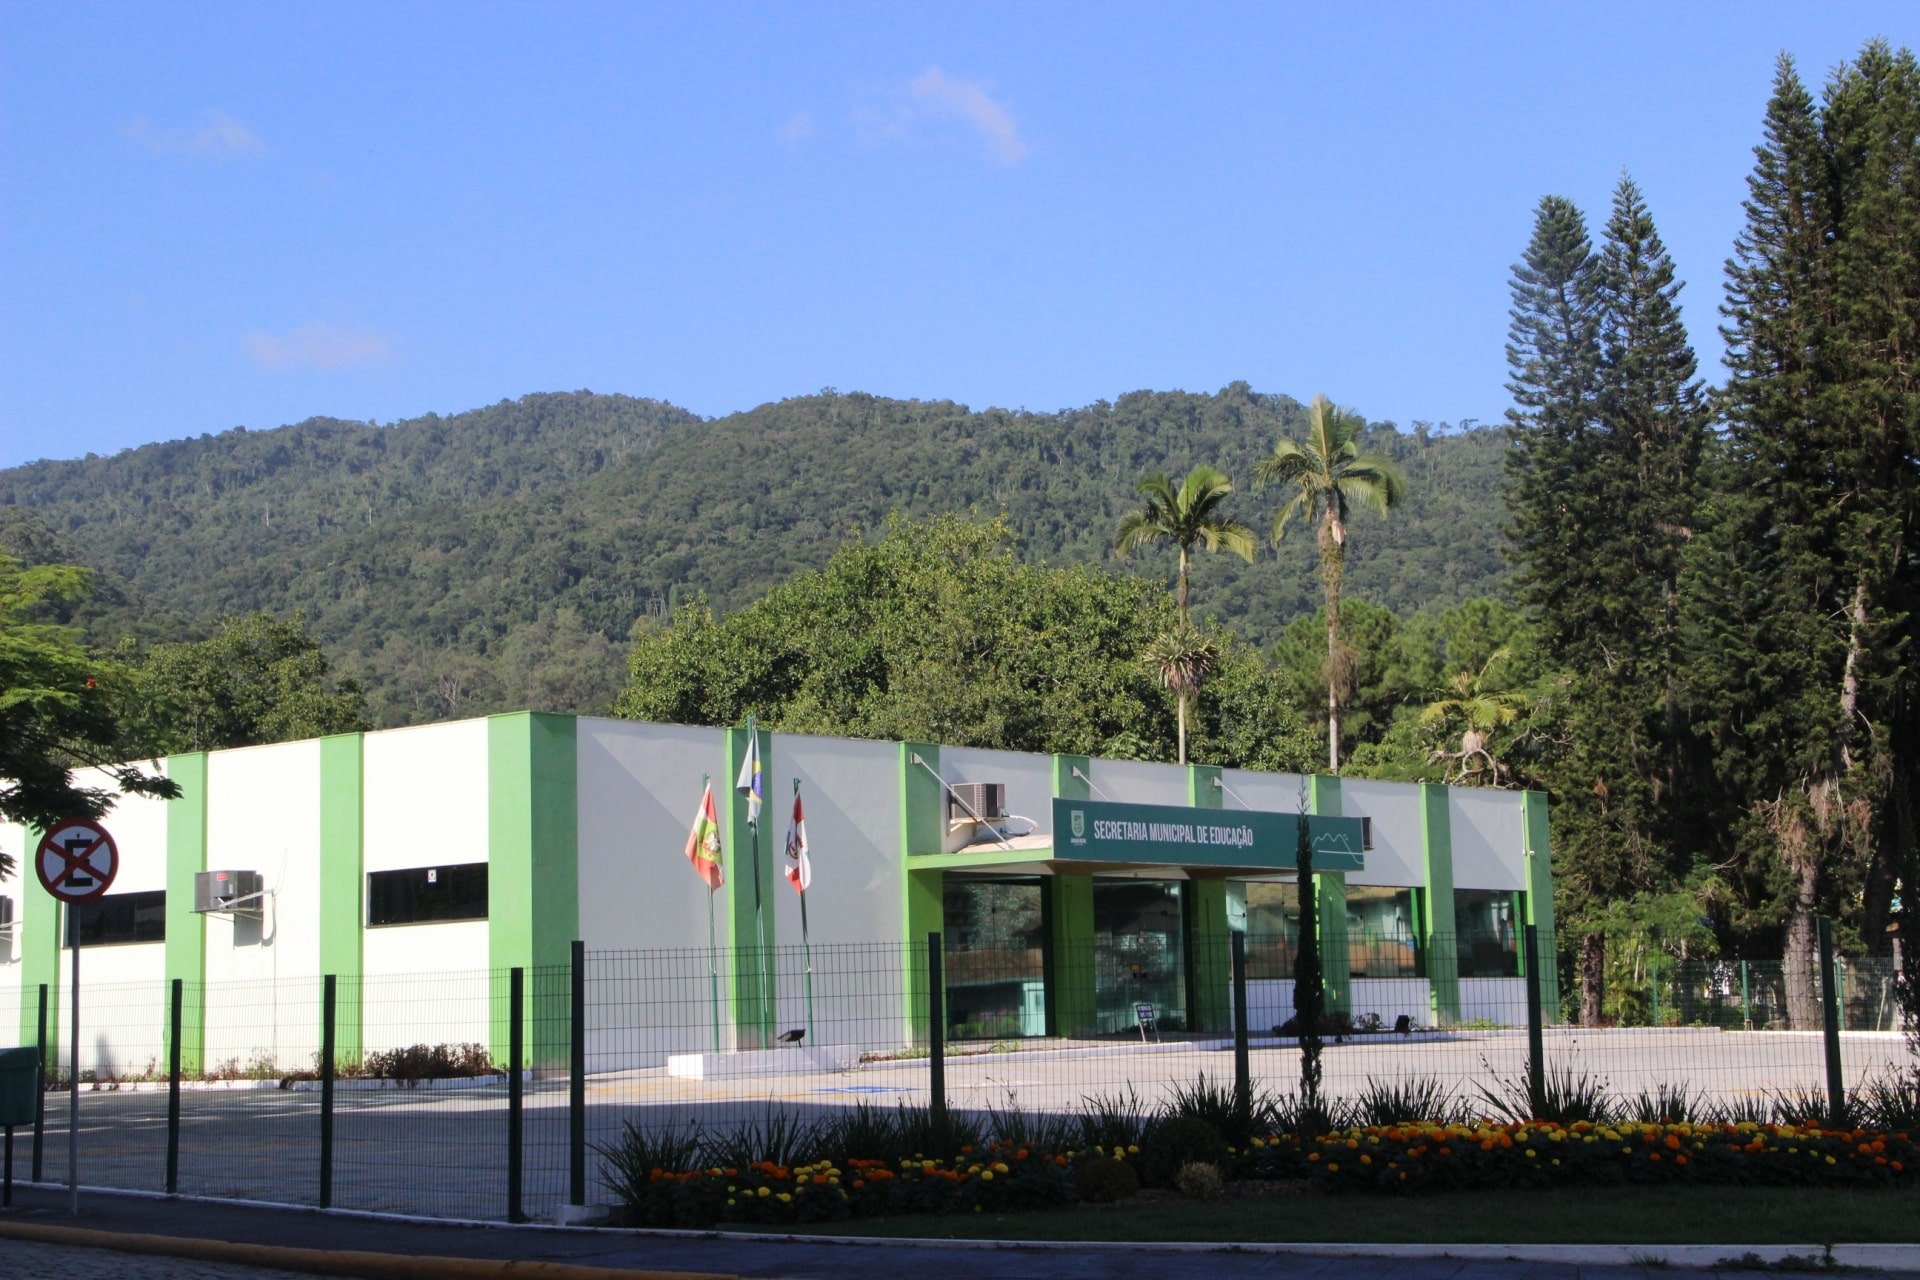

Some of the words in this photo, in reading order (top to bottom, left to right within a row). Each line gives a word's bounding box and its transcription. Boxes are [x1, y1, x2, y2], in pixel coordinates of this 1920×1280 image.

[1094, 820, 1148, 841] SECRETARIA
[1149, 823, 1196, 843] MUNICIPAL
[1197, 825, 1208, 844] DE
[1210, 825, 1253, 849] EDUCAÇÃO
[65, 839, 93, 887] E
